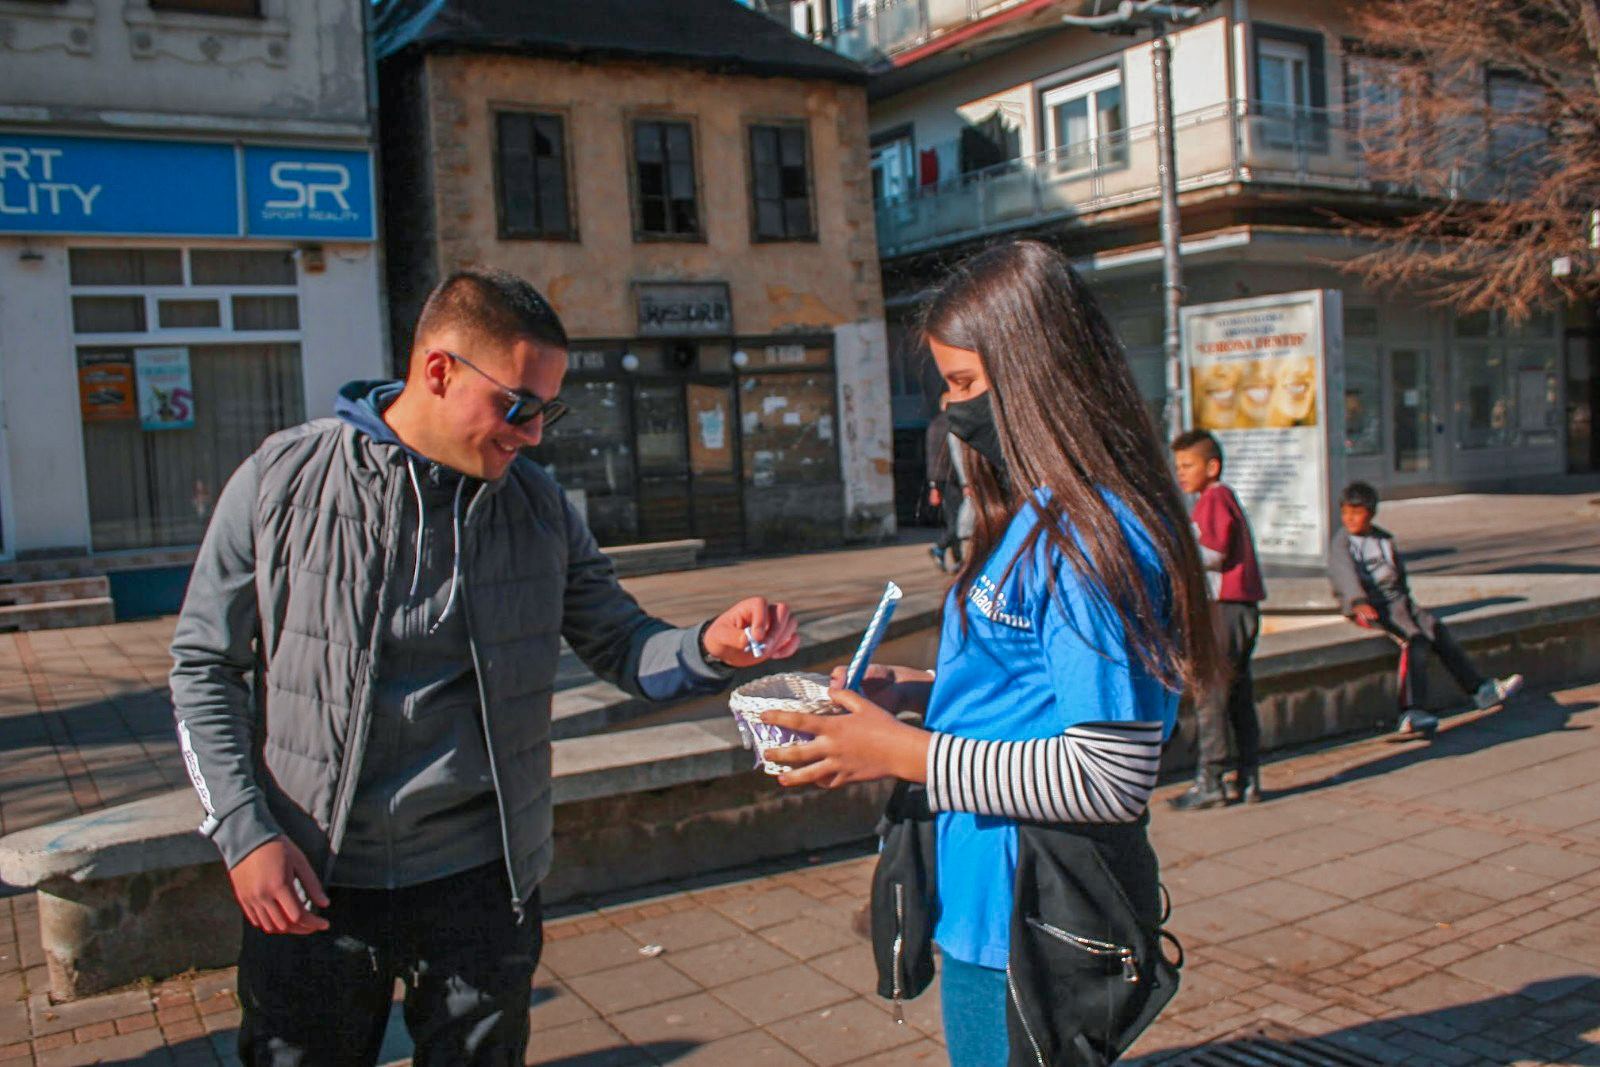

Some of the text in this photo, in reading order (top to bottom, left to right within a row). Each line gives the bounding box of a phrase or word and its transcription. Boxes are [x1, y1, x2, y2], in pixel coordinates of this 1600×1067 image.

[0, 147, 62, 180] RT
[0, 183, 101, 214] LITY
[265, 162, 350, 209] SR
